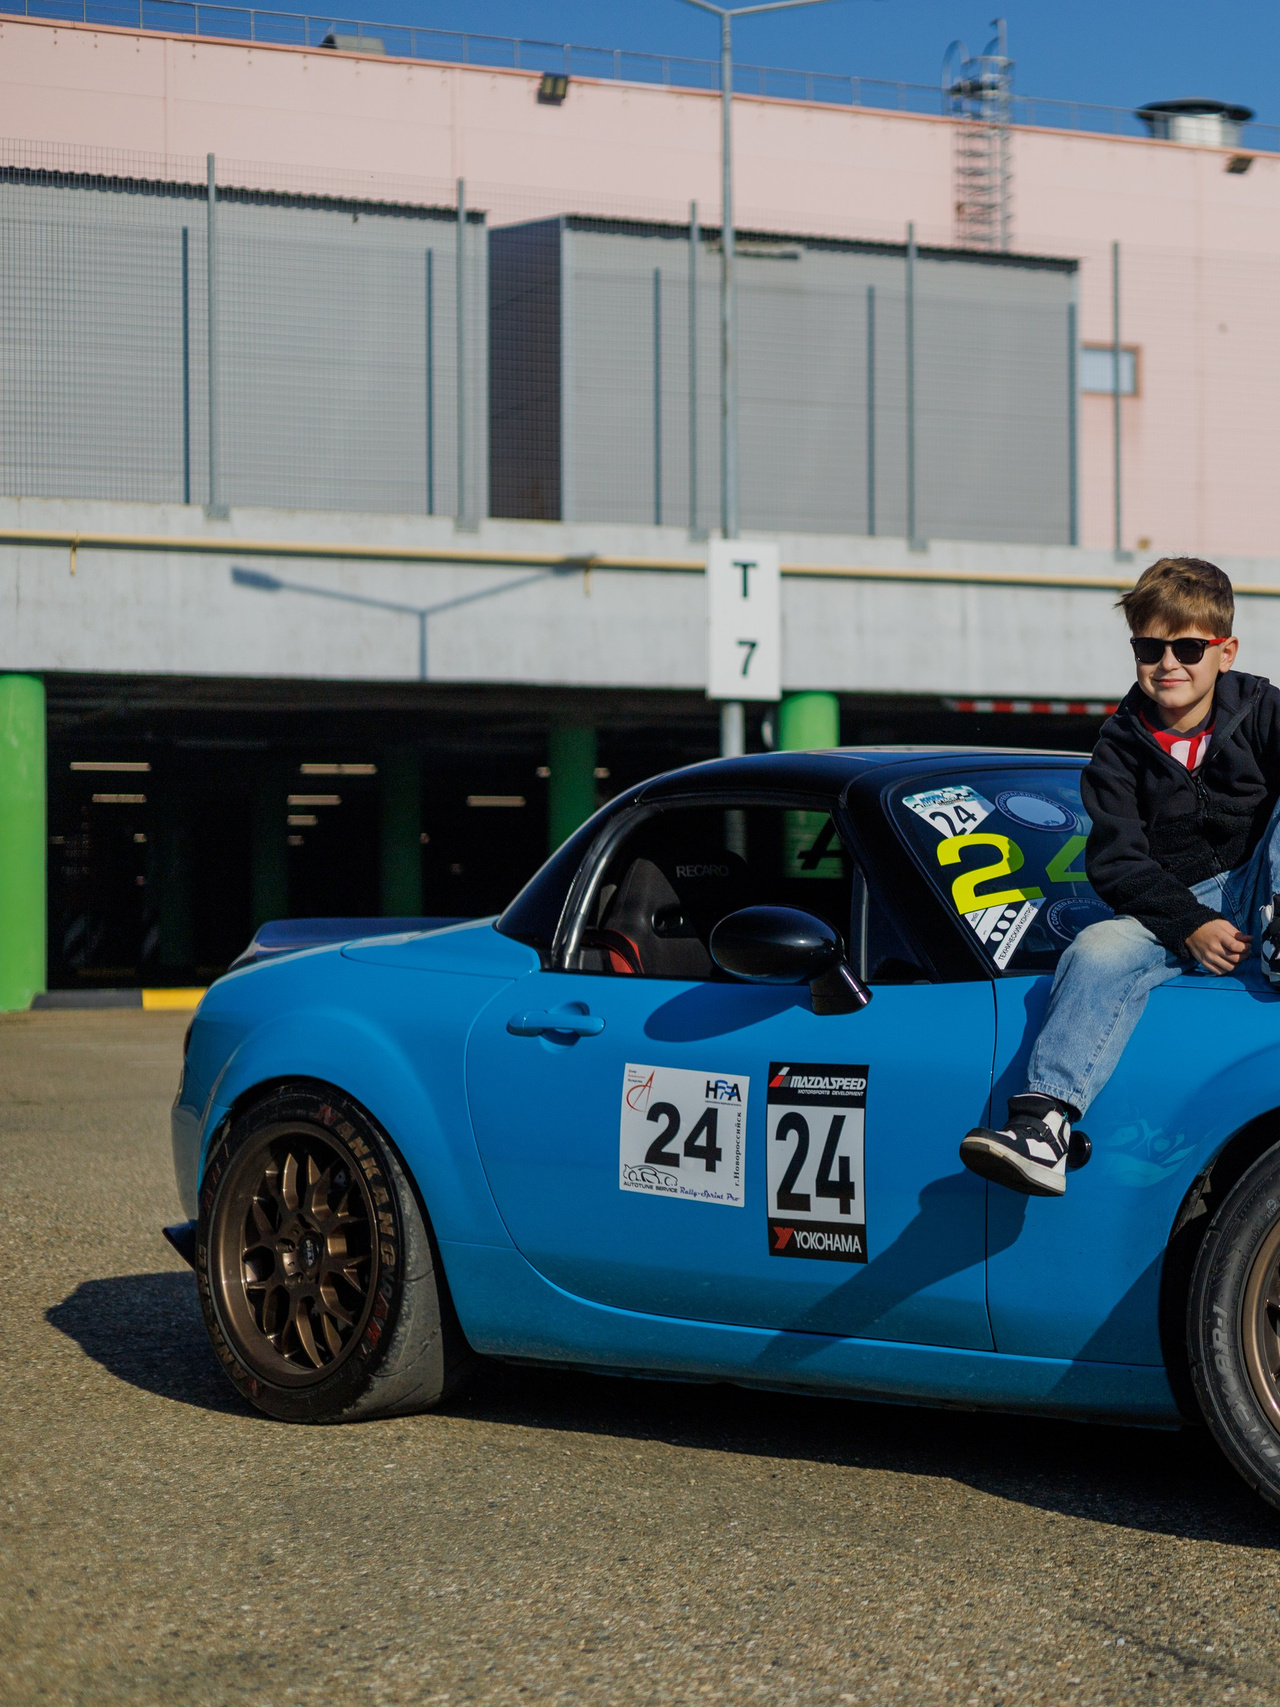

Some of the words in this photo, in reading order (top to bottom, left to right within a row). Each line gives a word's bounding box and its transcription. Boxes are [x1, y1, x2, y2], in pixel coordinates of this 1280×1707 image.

[732, 560, 758, 598] T
[737, 640, 758, 677] 7
[929, 805, 977, 837] 24
[676, 864, 730, 879] RECARO
[789, 1075, 867, 1091] MAZDASPEED
[644, 1101, 722, 1173] 24
[733, 1112, 742, 1187] г.Новороссийск
[775, 1111, 855, 1215] 24
[316, 1104, 396, 1268] NANKANG
[623, 1181, 654, 1190] AUTOTUNE
[655, 1185, 678, 1193] SERVICE
[679, 1186, 724, 1199] Rally-Sprint
[726, 1192, 740, 1202] Pro
[793, 1230, 862, 1254] YOKOHAMA
[1212, 1304, 1234, 1381] AR-1
